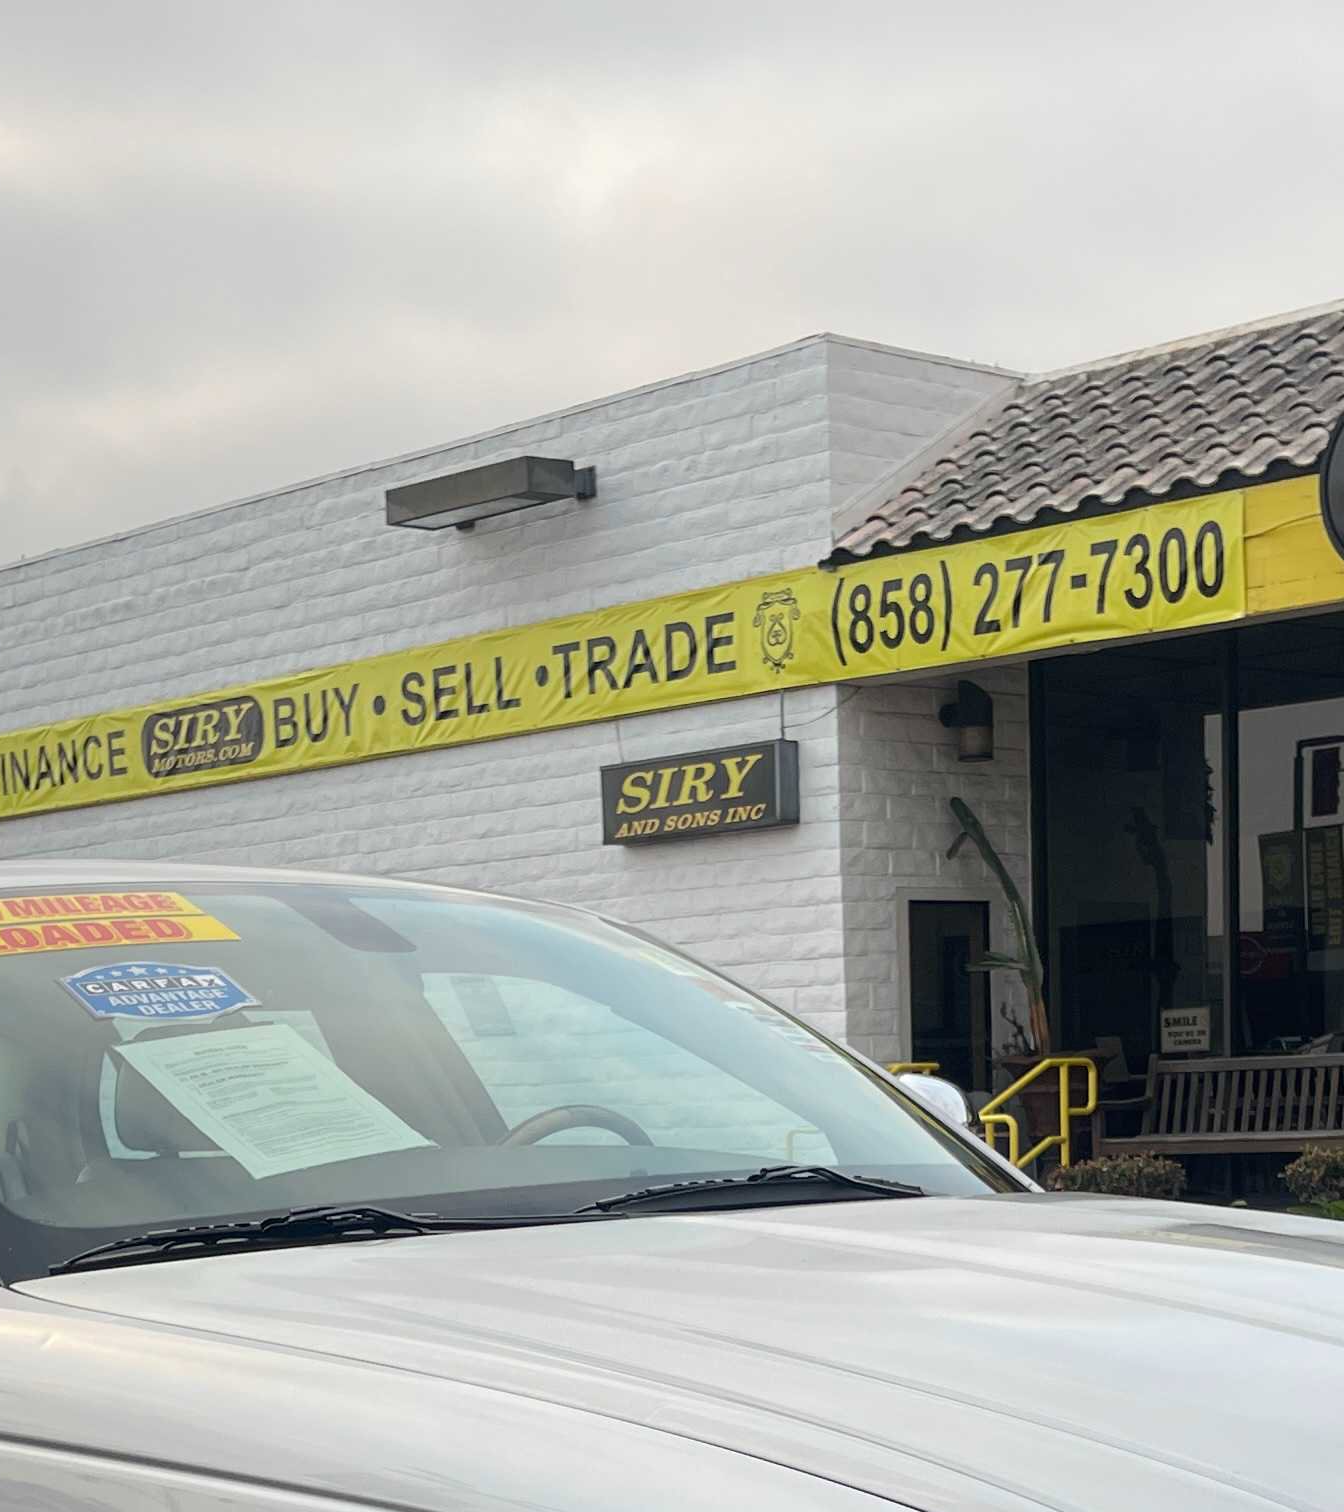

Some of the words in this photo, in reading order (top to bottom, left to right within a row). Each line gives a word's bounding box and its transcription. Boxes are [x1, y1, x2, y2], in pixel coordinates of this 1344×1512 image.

[832, 560, 952, 666] (858)
[973, 520, 1224, 636] 277-7300
[273, 683, 359, 748] BUY
[400, 657, 521, 726] SELL
[552, 612, 737, 698] TRADE
[150, 703, 254, 755] SIRY
[151, 741, 253, 774] MOTORS.COM
[617, 754, 763, 814] SIRY
[615, 818, 660, 840] AND
[664, 810, 721, 833] SONS
[725, 803, 766, 824] INC
[3, 893, 184, 923] MILEAGE
[79, 974, 227, 996] CARFAX
[108, 989, 228, 1009] ADVANTAGE
[140, 1000, 221, 1017] DEALER
[1163, 1015, 1198, 1029] SMILE
